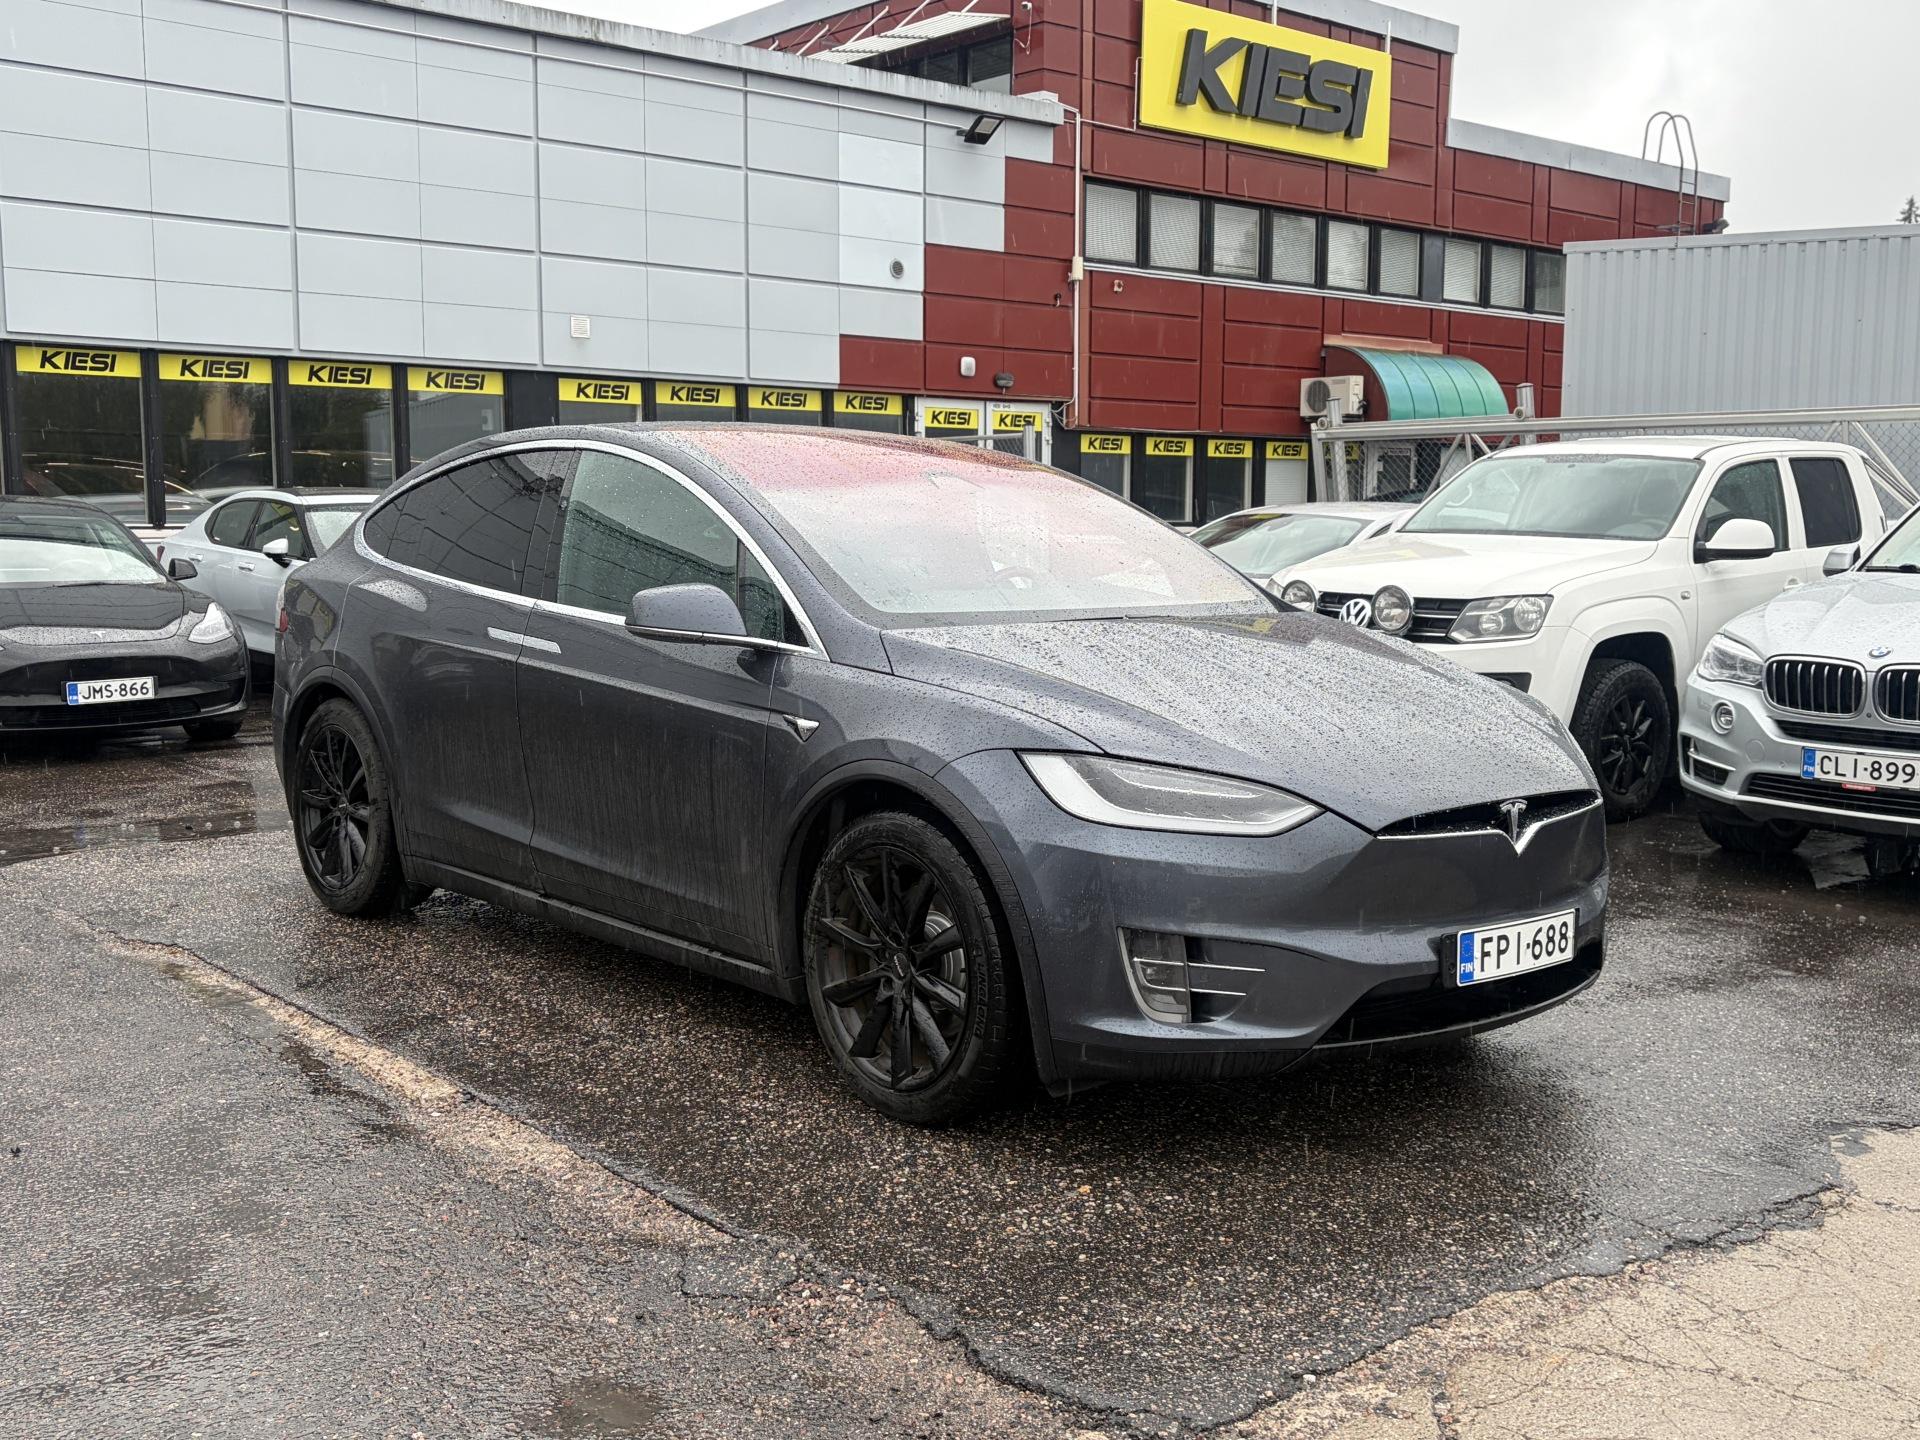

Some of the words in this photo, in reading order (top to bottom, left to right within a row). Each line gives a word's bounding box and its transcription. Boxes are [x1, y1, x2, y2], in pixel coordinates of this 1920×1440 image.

[1176, 28, 1373, 138] KIESI
[40, 350, 117, 372] KIESI
[180, 359, 250, 378] KIESI
[308, 365, 372, 384] KIESI
[426, 371, 486, 390] KIESI
[577, 382, 629, 400] KIESI
[670, 385, 720, 403] KIESI
[761, 391, 807, 407] KIESI
[845, 395, 888, 411] KIESI
[931, 411, 971, 425] KIESI
[999, 414, 1036, 428] KIESI
[1088, 437, 1123, 451] KIESI
[1153, 440, 1186, 453] KIESI
[1214, 442, 1245, 455] KIESI
[1272, 444, 1302, 456] KIESI
[82, 682, 149, 700] JMS-866
[1820, 755, 1915, 783] CLI-899
[1460, 962, 1473, 973] FIN
[1480, 921, 1568, 972] FPI-688
